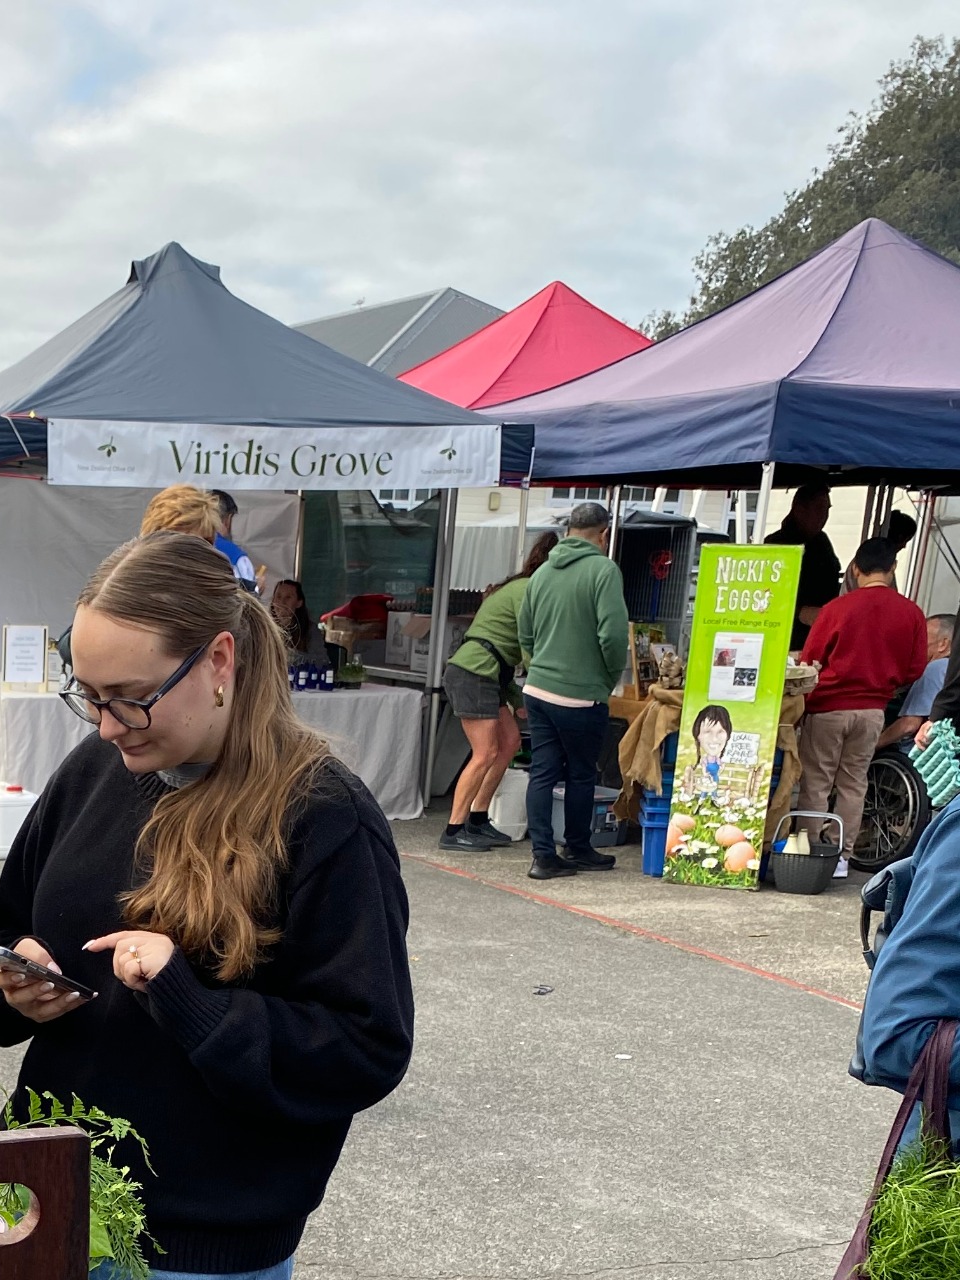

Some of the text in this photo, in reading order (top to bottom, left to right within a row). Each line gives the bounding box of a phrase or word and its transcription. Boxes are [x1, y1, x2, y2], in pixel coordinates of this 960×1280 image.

[169, 438, 394, 477] Viridis Grove
[714, 586, 762, 614] EGGS
[722, 618, 738, 626] Free
[739, 619, 762, 627] Range
[763, 620, 781, 628] Eggs
